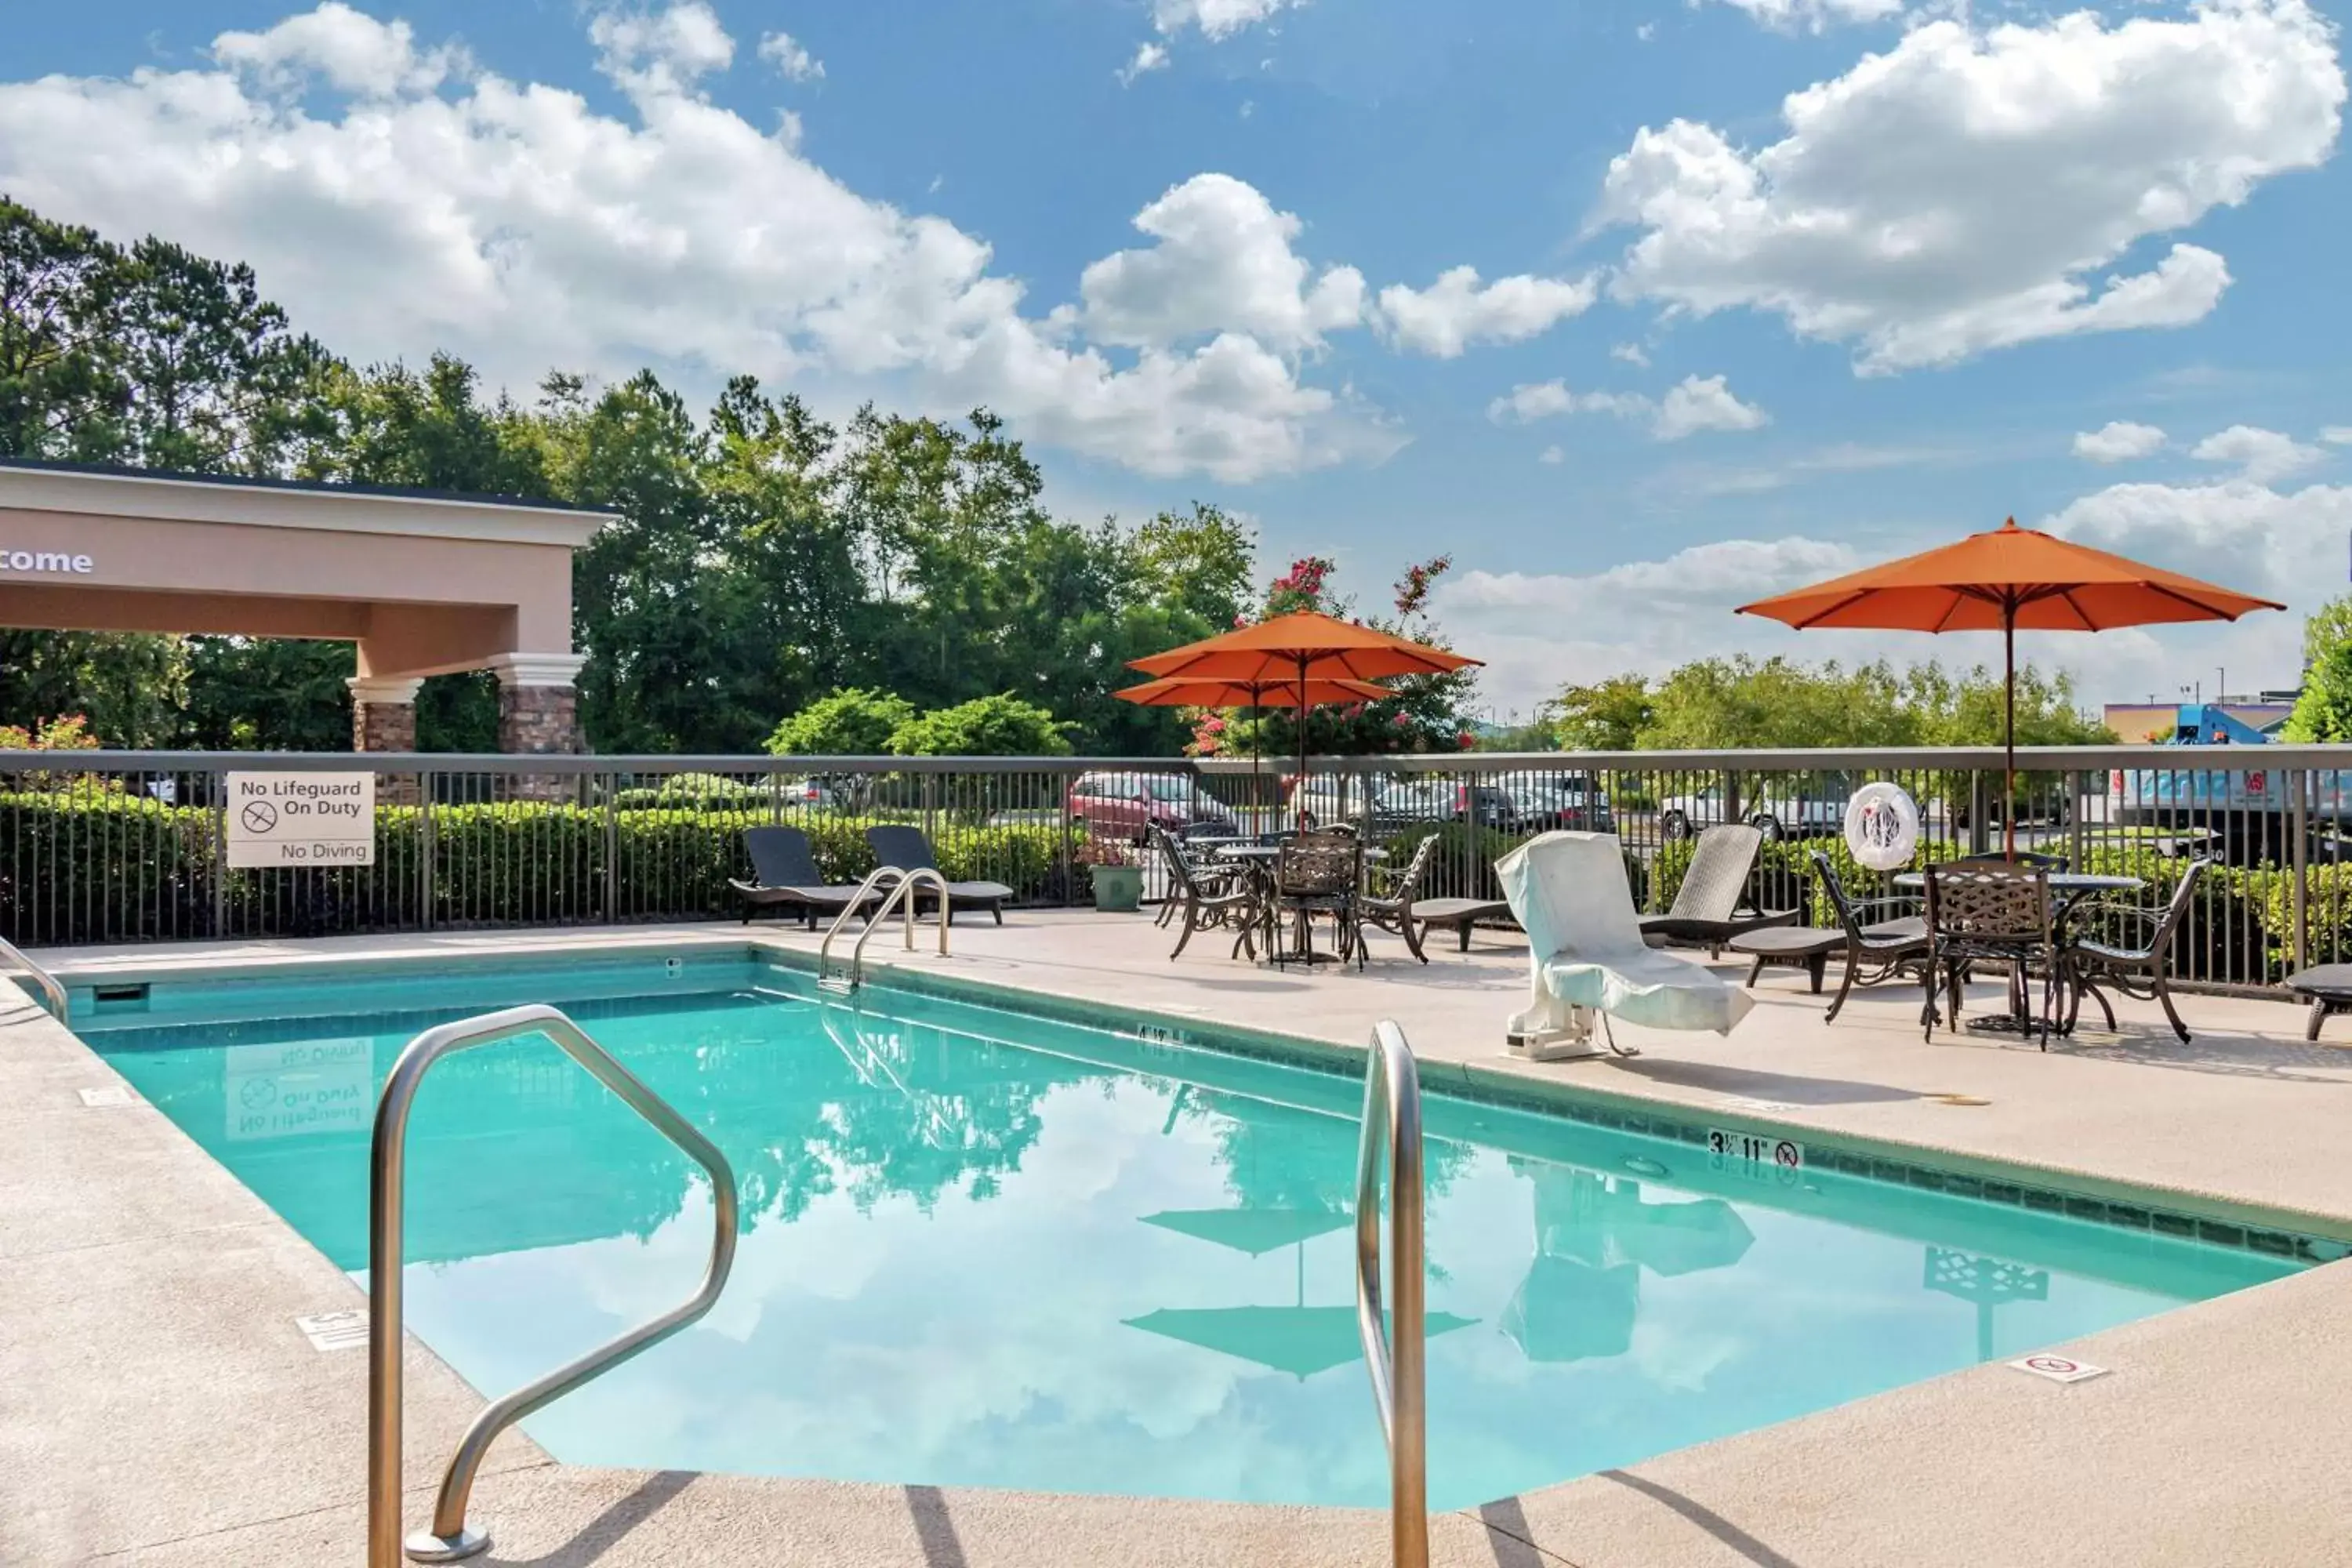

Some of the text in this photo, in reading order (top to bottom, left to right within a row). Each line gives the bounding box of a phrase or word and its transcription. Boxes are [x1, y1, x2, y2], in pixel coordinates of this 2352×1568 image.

[241, 780, 361, 799] No Lifeguard
[284, 800, 361, 818] On Duty
[281, 843, 367, 862] No Diving
